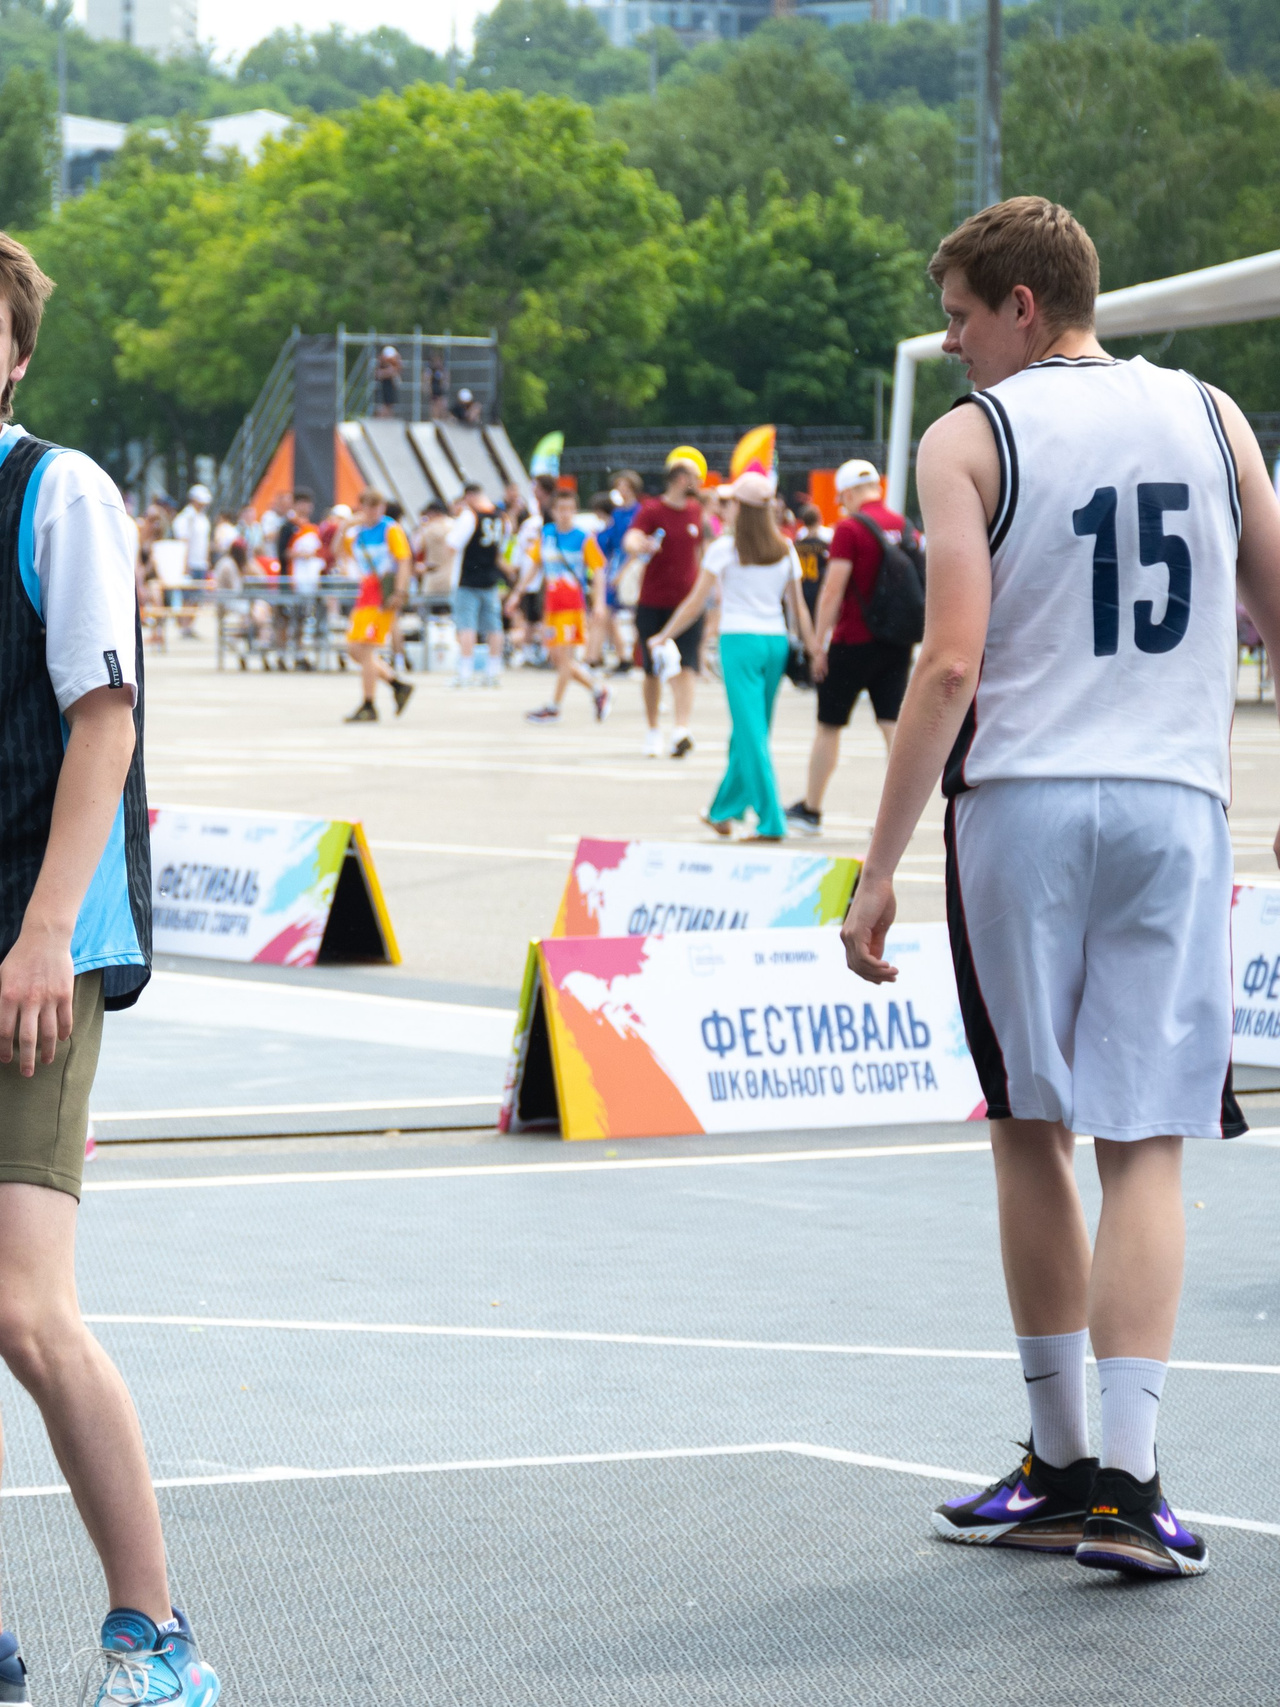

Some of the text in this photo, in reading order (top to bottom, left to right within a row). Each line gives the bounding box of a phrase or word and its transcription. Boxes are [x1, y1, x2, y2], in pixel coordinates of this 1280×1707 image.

[1072, 482, 1192, 657] 15
[107, 652, 120, 687] ATTIZZARE
[157, 864, 260, 906] ФЕСТИВАЛЬ
[701, 1000, 931, 1059] ФЕСТИВАЛЬ
[708, 1060, 939, 1102] ШКОЛЬНОГО СПОРТА
